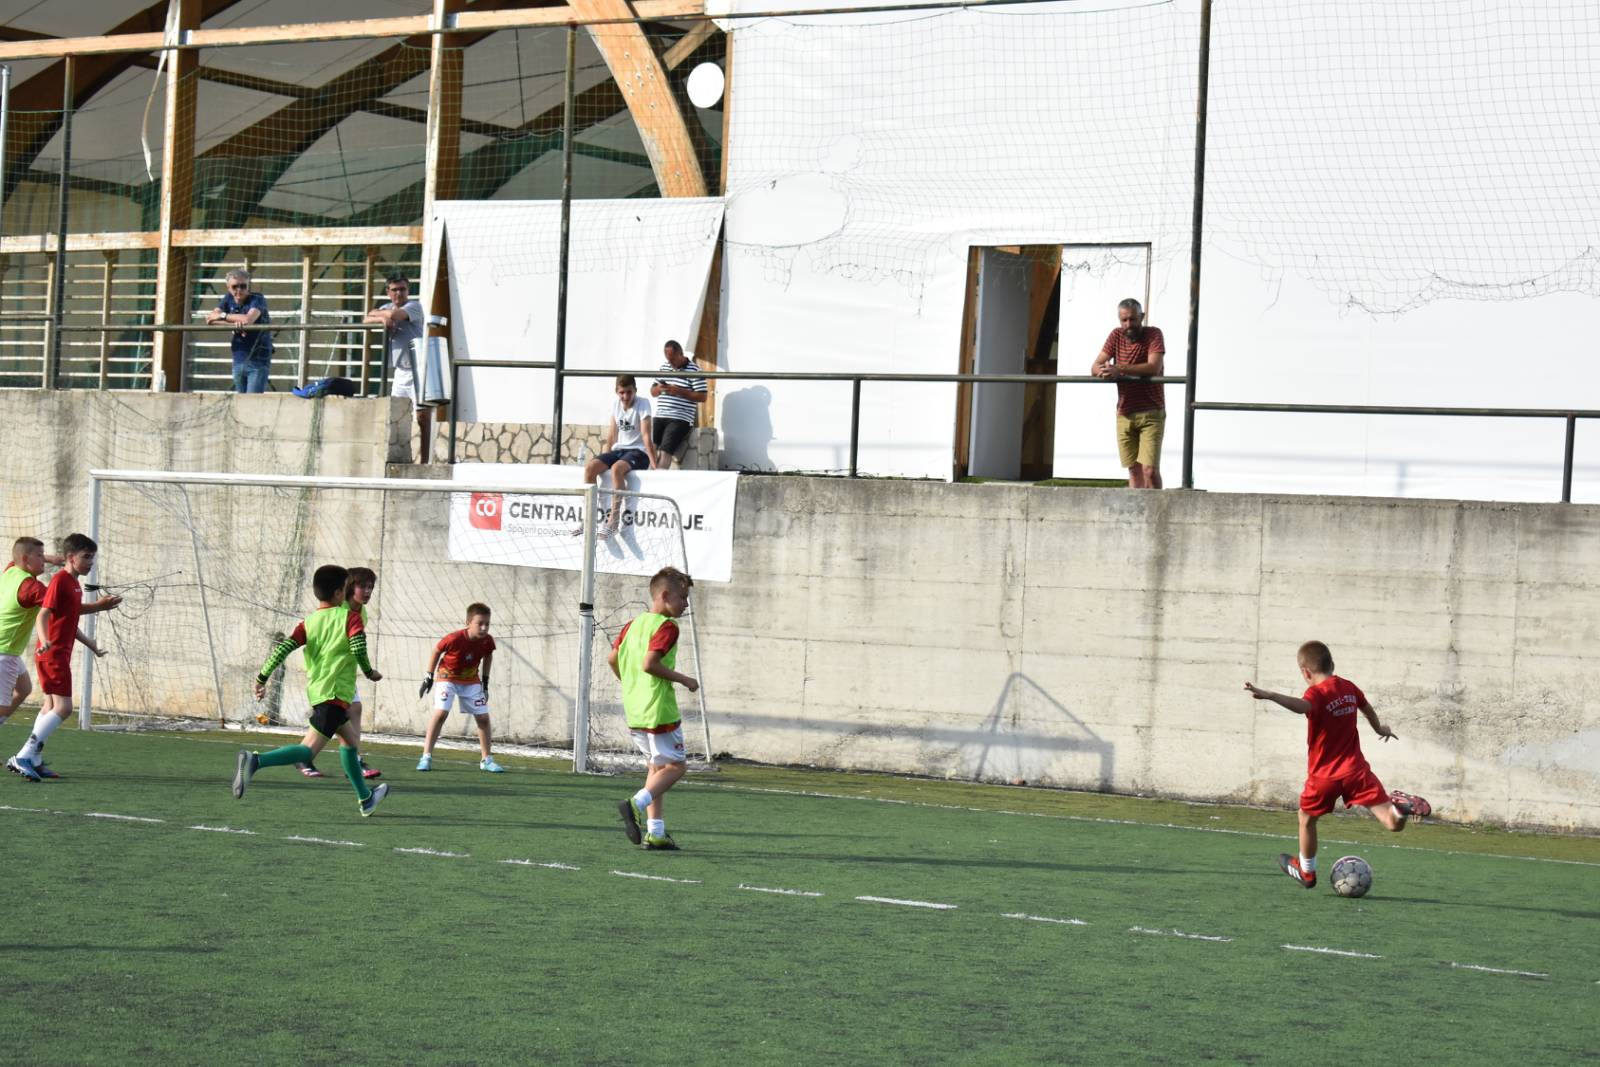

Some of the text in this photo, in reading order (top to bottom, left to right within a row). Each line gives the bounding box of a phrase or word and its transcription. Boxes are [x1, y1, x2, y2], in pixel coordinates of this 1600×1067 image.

[475, 499, 496, 516] CO
[509, 502, 584, 522] CENTRAL
[596, 508, 704, 530] OSGURANJE
